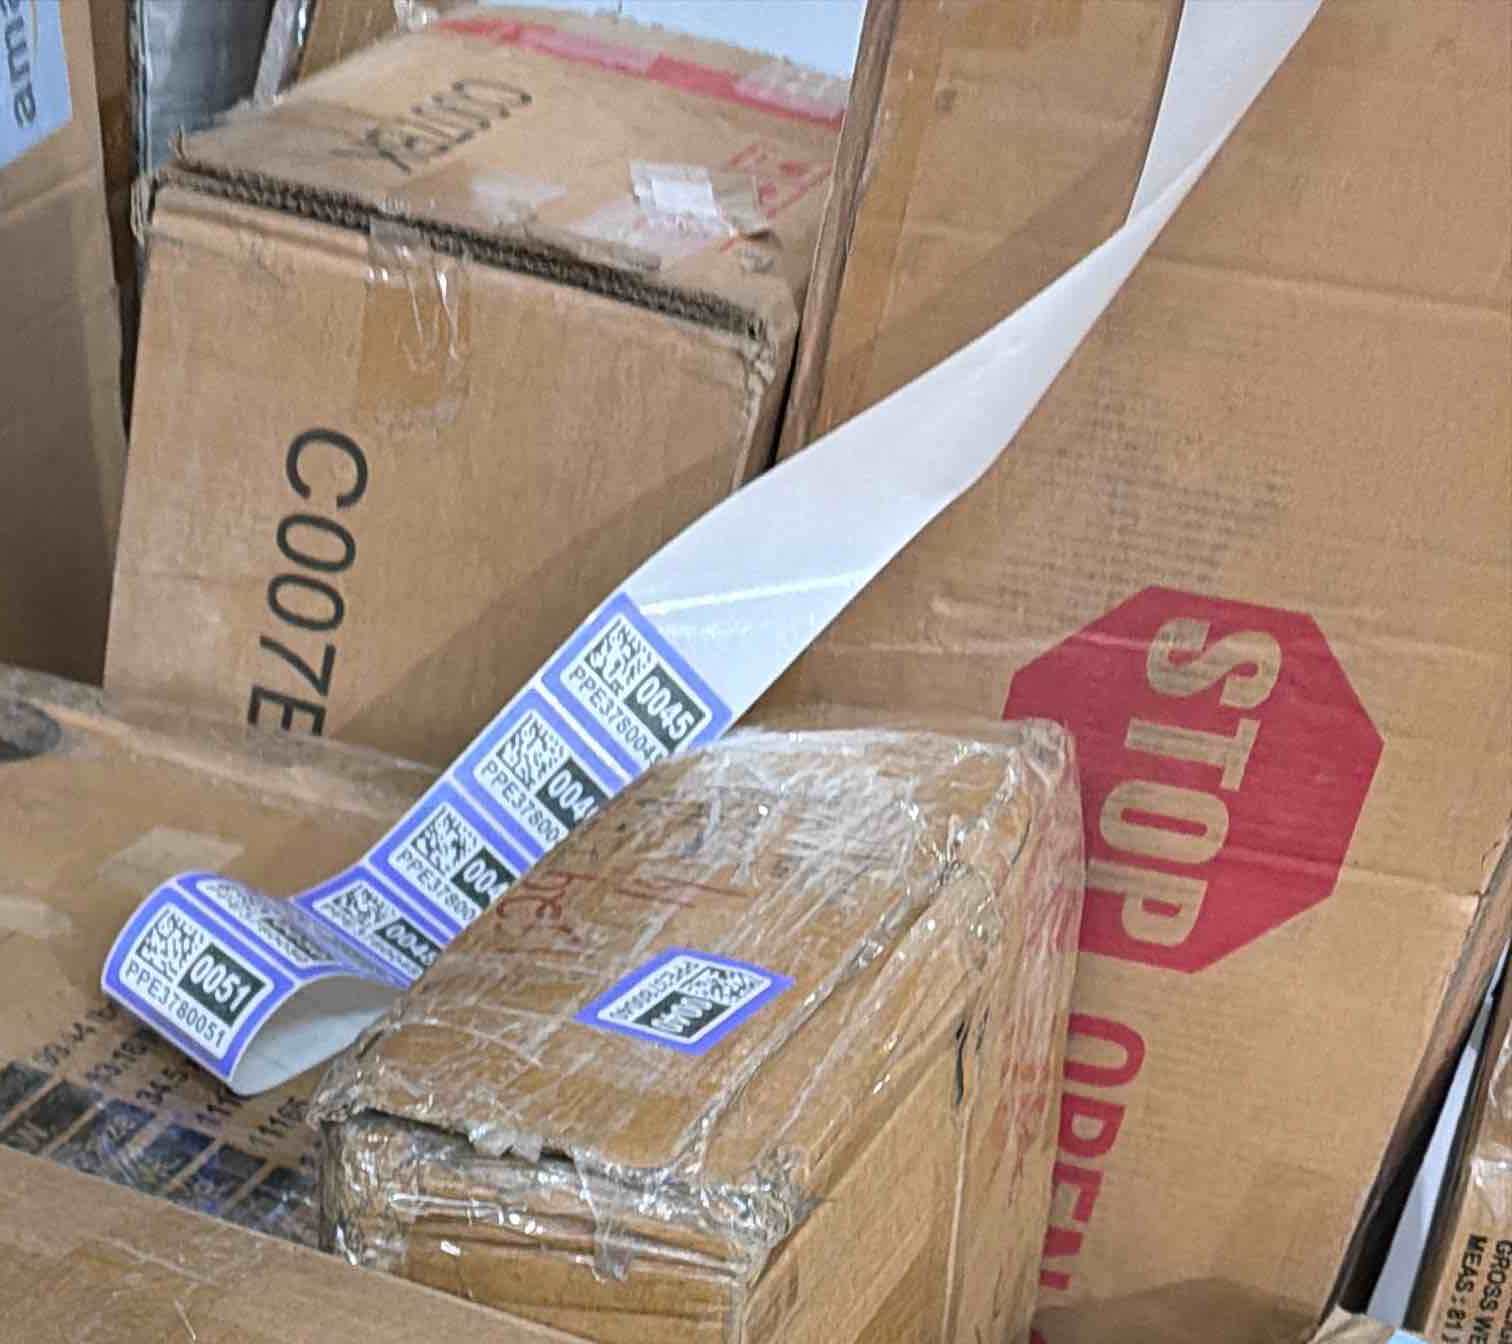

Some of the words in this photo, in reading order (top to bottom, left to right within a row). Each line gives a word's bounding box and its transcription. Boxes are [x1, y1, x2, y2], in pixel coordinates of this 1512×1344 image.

[247, 429, 369, 737] C007E
[635, 675, 695, 741] 0045
[548, 769, 600, 822] 004
[1085, 617, 1282, 948] STOP
[124, 962, 226, 1049] PPE3780051
[189, 954, 251, 1012] 0051
